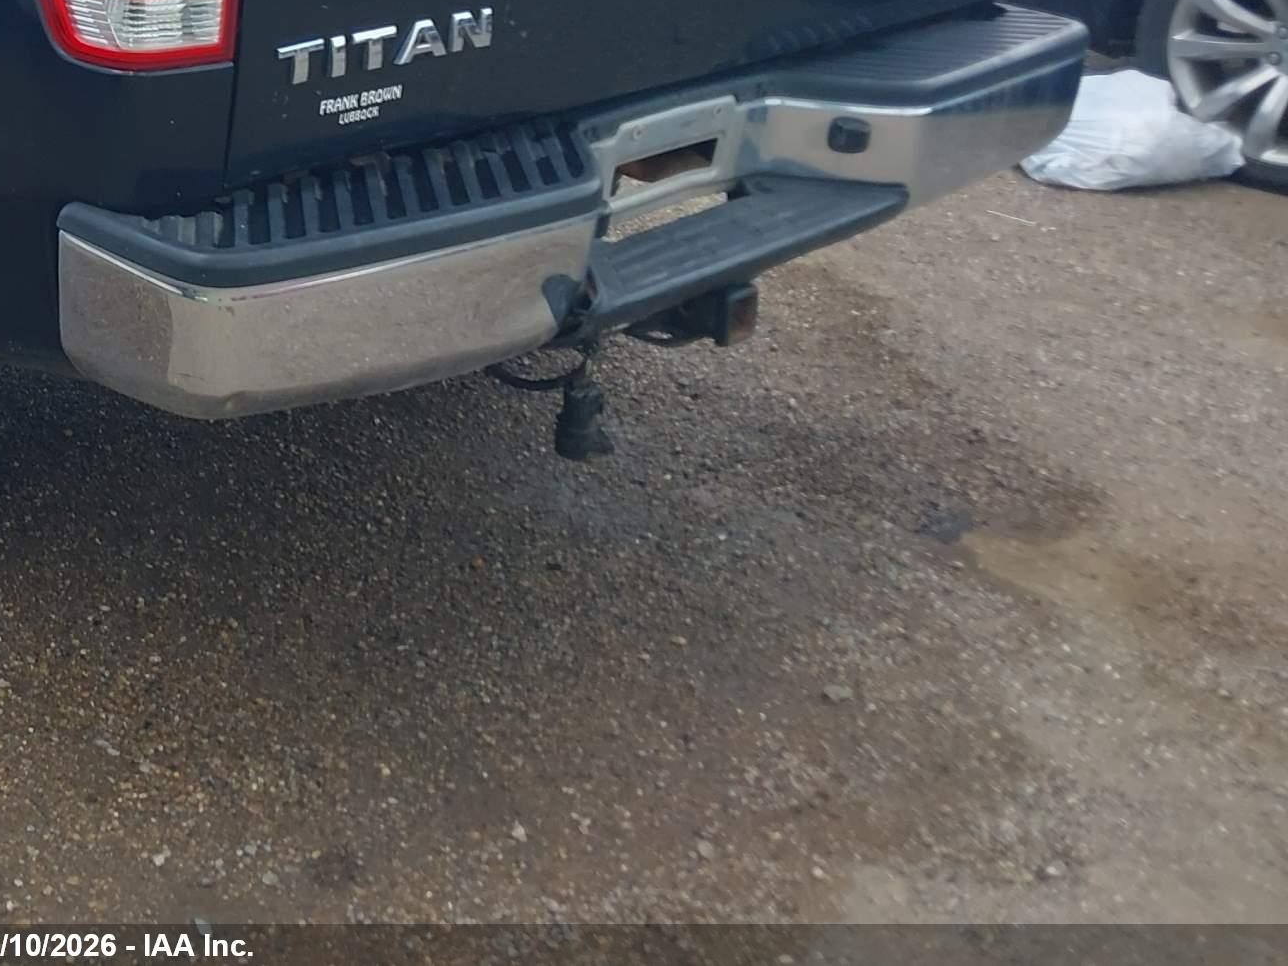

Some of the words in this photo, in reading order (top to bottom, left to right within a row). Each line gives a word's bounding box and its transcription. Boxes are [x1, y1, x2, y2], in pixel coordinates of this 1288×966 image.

[277, 7, 493, 85] TITAN
[319, 94, 359, 116] FRANK
[360, 85, 403, 107] BROWN
